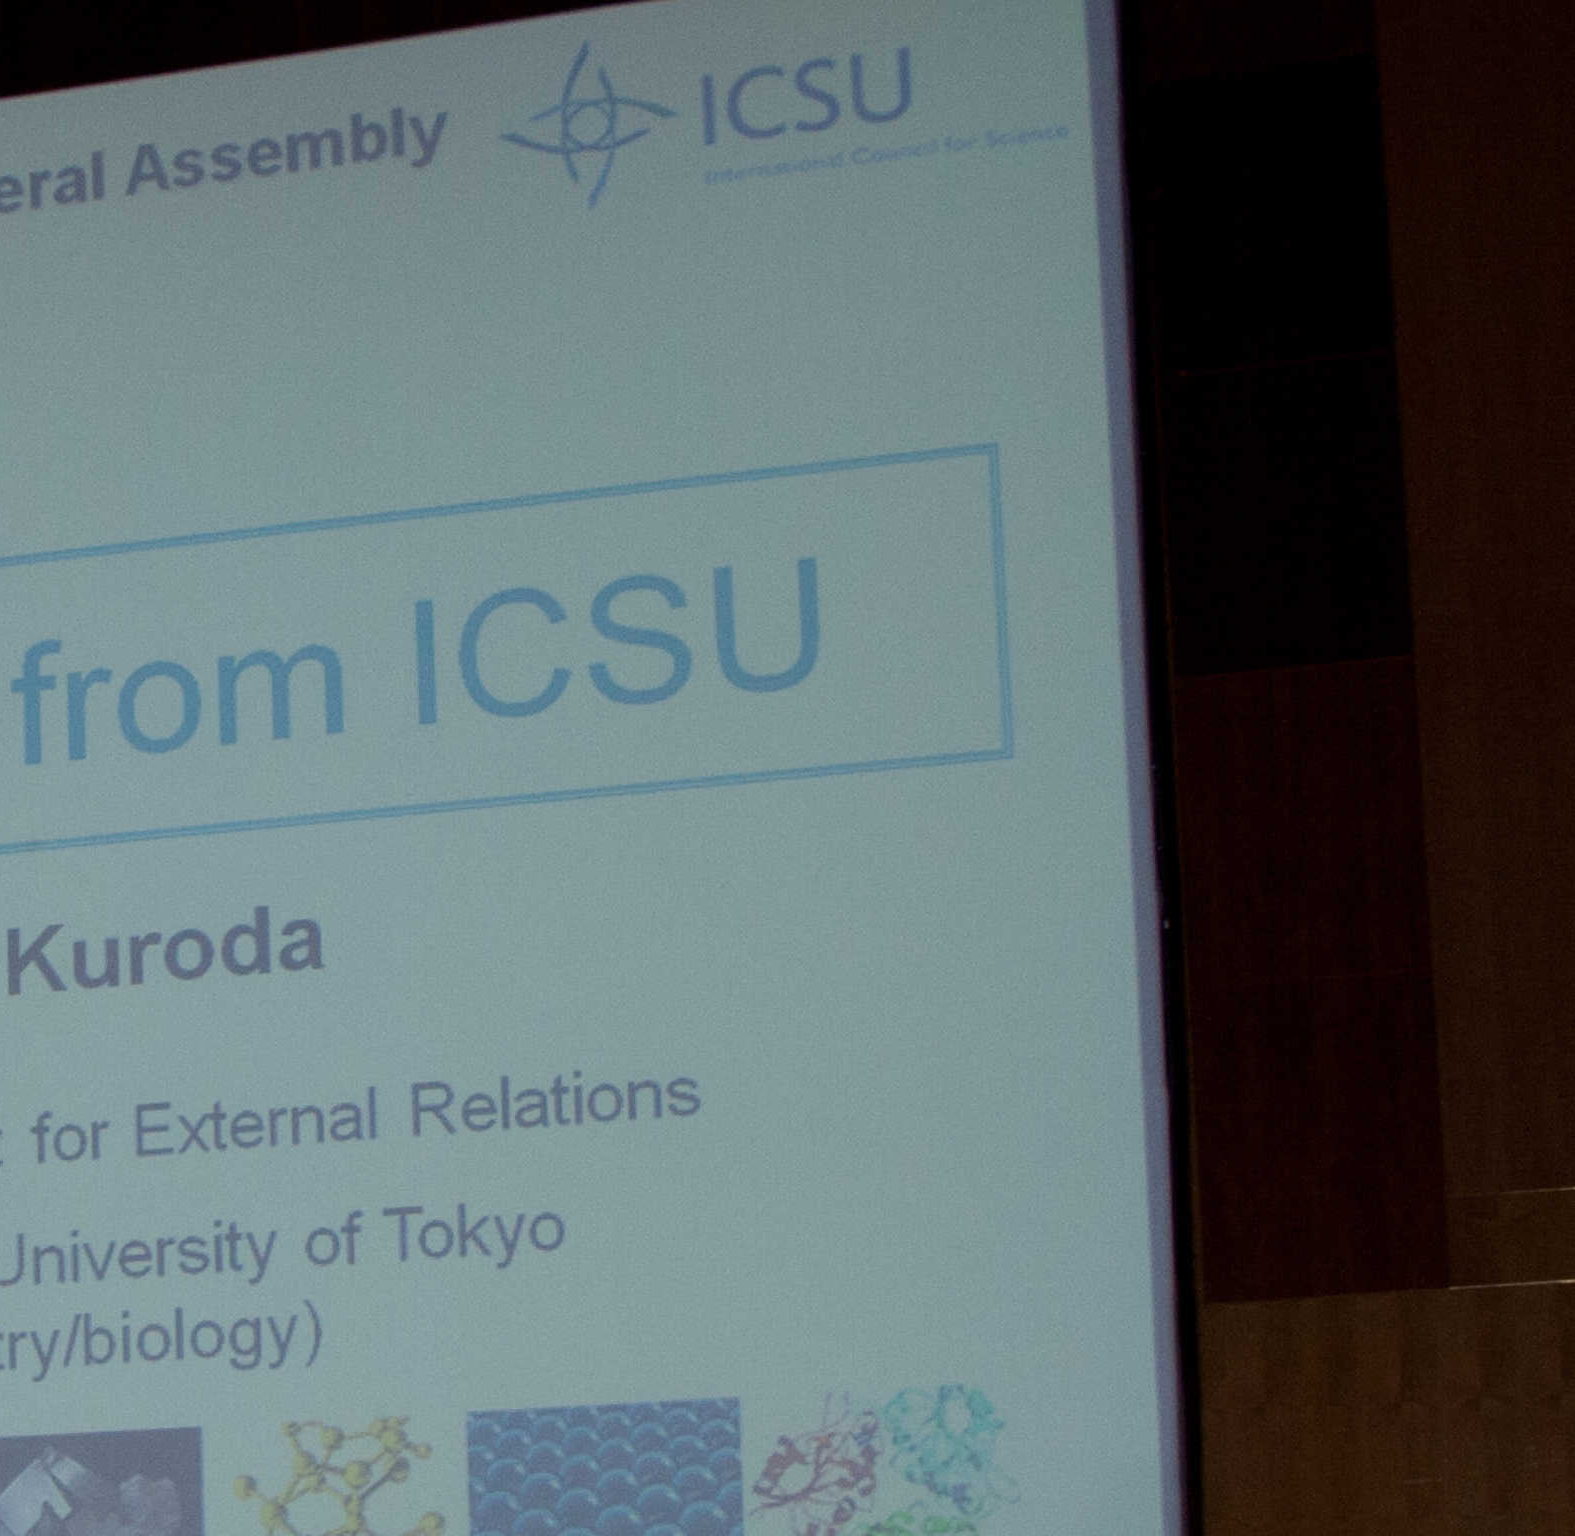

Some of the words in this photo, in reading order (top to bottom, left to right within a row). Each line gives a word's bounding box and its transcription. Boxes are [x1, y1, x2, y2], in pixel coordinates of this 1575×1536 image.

[701, 46, 914, 146] ICSU
[124, 106, 448, 199] Assembly
[11, 639, 345, 766] from
[415, 556, 823, 725] ICSU
[6, 904, 324, 996] Kuroda
[30, 1111, 110, 1164] for
[135, 1086, 378, 1158] External
[412, 1071, 701, 1137] Relations
[305, 1209, 363, 1268] of
[383, 1202, 565, 1270] Tokyo
